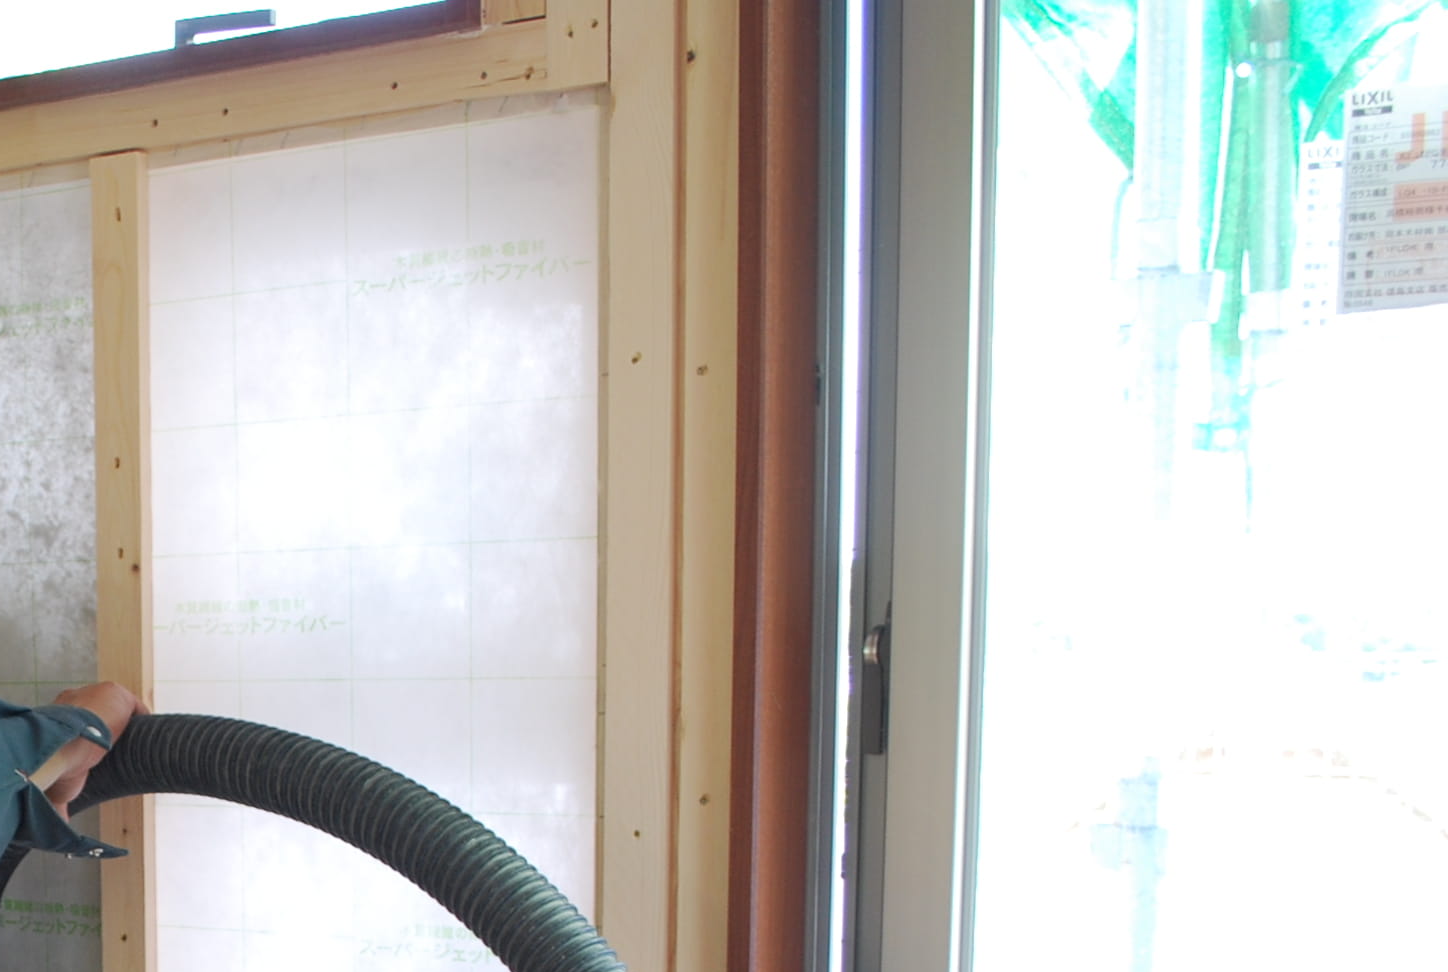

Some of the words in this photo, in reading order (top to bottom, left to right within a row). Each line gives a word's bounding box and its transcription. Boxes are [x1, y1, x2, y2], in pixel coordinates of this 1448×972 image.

[1352, 90, 1394, 105] LIXIL
[1308, 146, 1340, 159] LIXI
[353, 255, 592, 297] スーパージェットファイバー
[152, 613, 347, 637] ーパージェットファイバー
